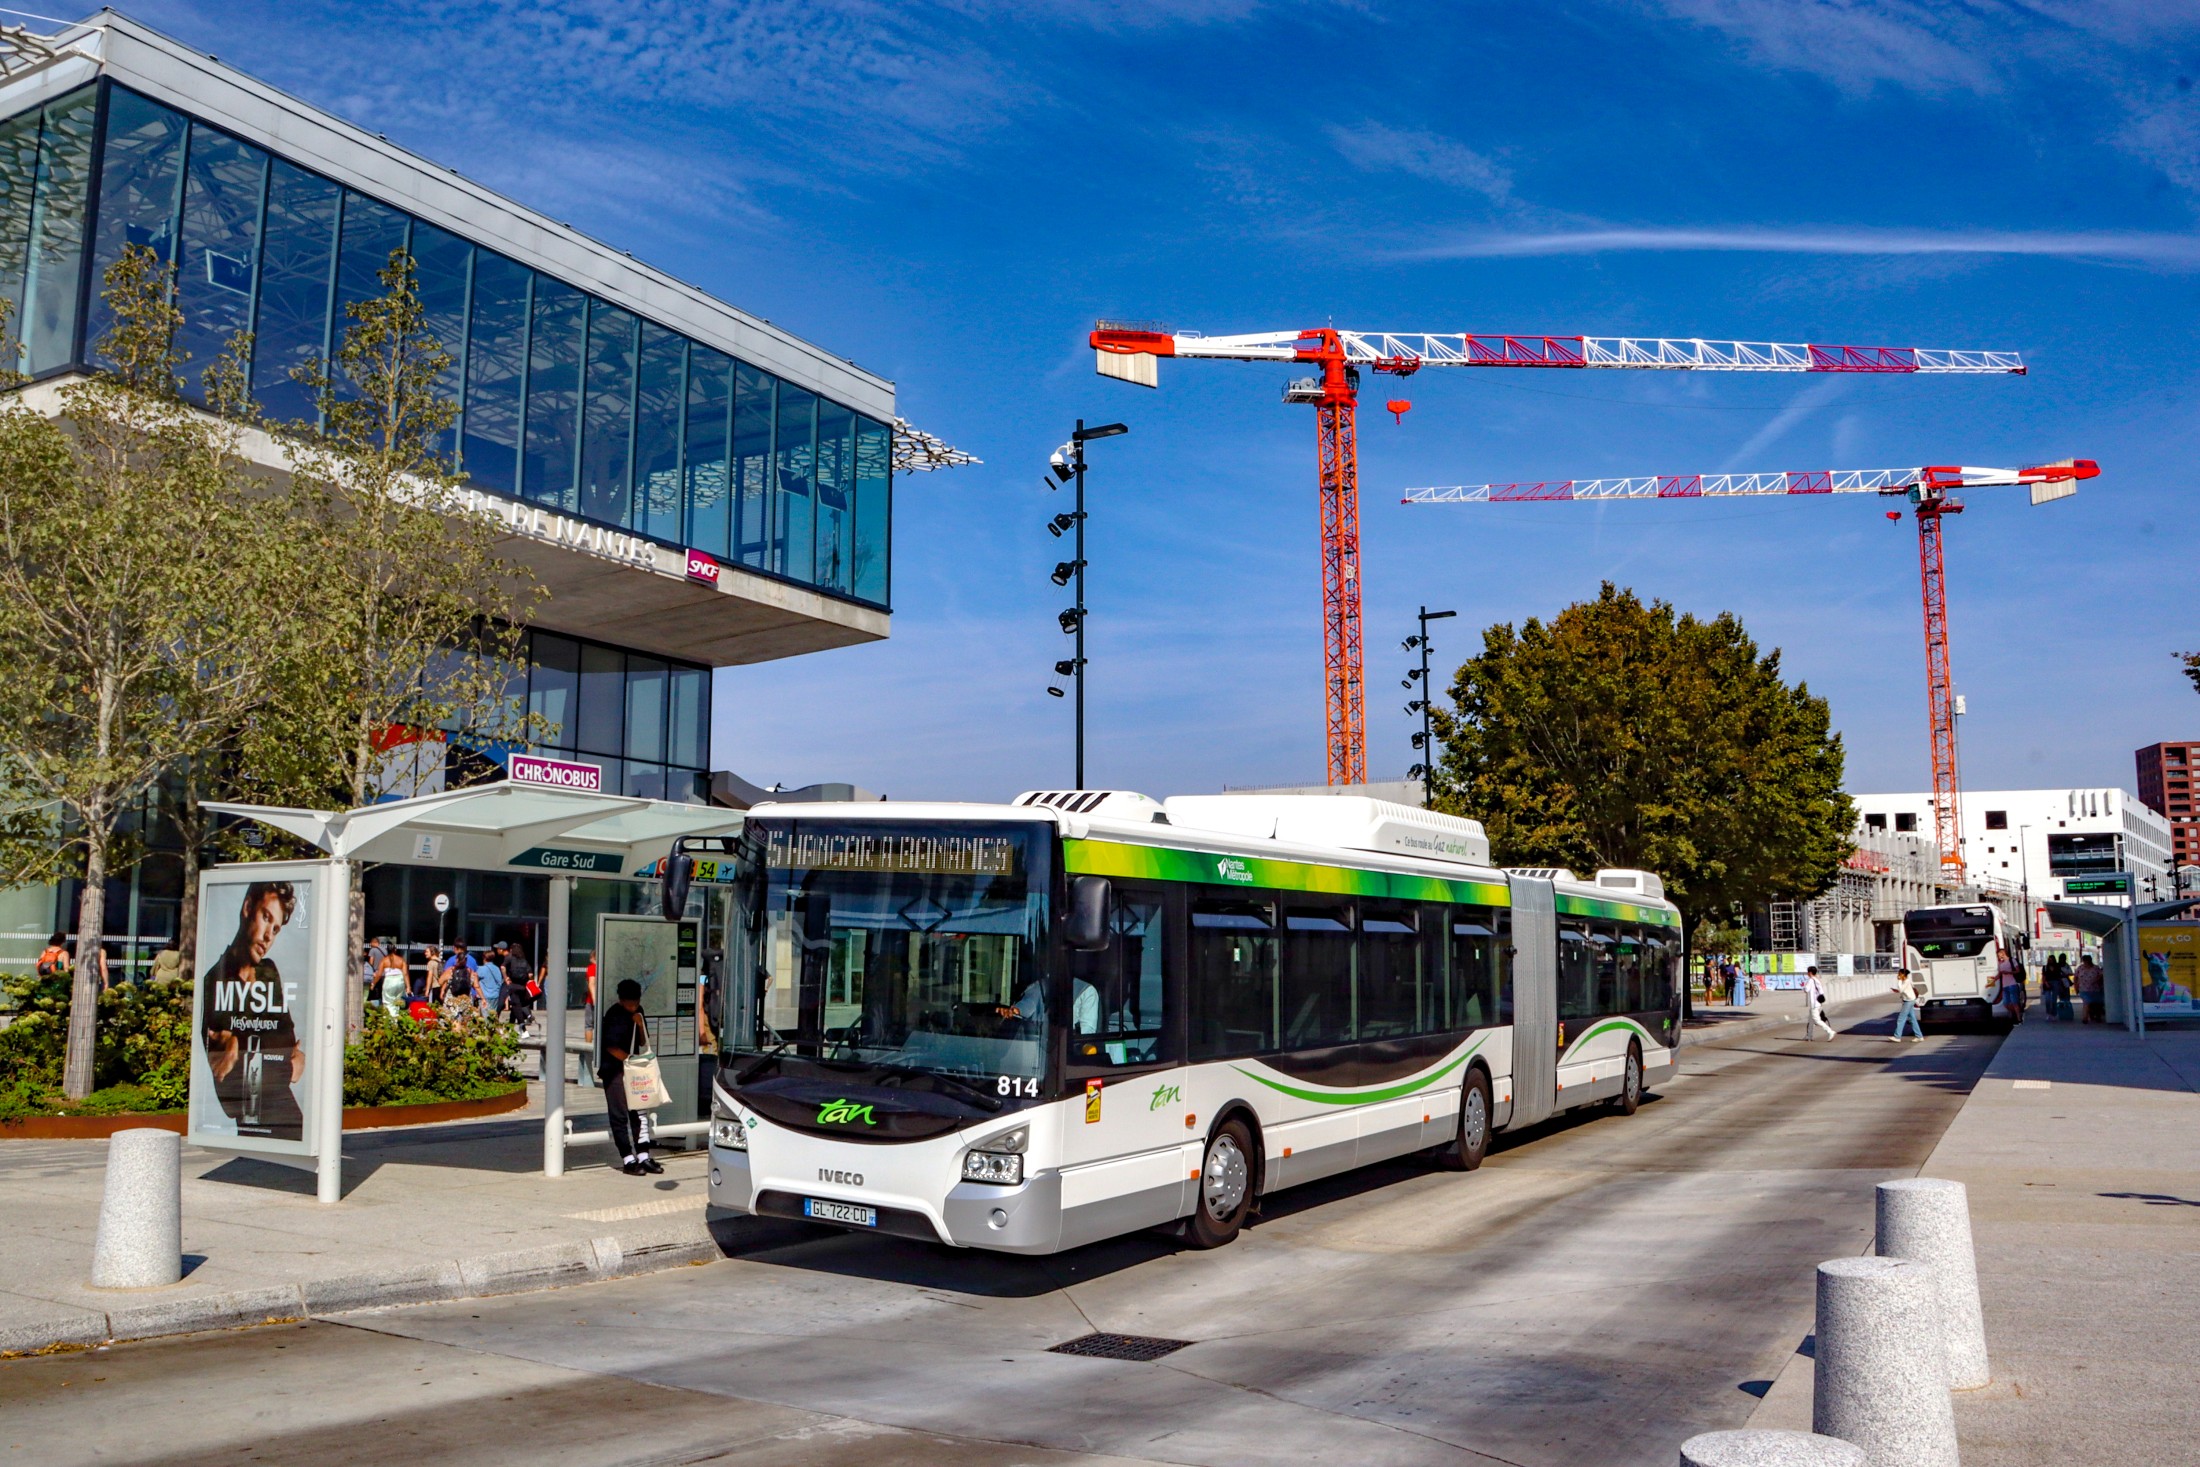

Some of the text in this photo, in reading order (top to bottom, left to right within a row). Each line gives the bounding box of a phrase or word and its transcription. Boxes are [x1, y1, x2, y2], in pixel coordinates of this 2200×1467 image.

[512, 502, 548, 536] DE
[557, 515, 657, 565] NANTES
[688, 559, 719, 577] SNCF
[515, 762, 597, 788] CHRONOBUS
[541, 851, 596, 869] Gare Sud
[766, 830, 783, 868] 5
[786, 834, 875, 868] HANGAR
[899, 836, 1007, 871] BANANES
[700, 862, 716, 877] 54
[1225, 858, 1245, 870] Nantes
[214, 980, 298, 1013] MYSLF
[997, 1076, 1038, 1097] 814
[1149, 1084, 1182, 1112] tan
[816, 1098, 877, 1125] tan
[818, 1168, 864, 1186] IVECO
